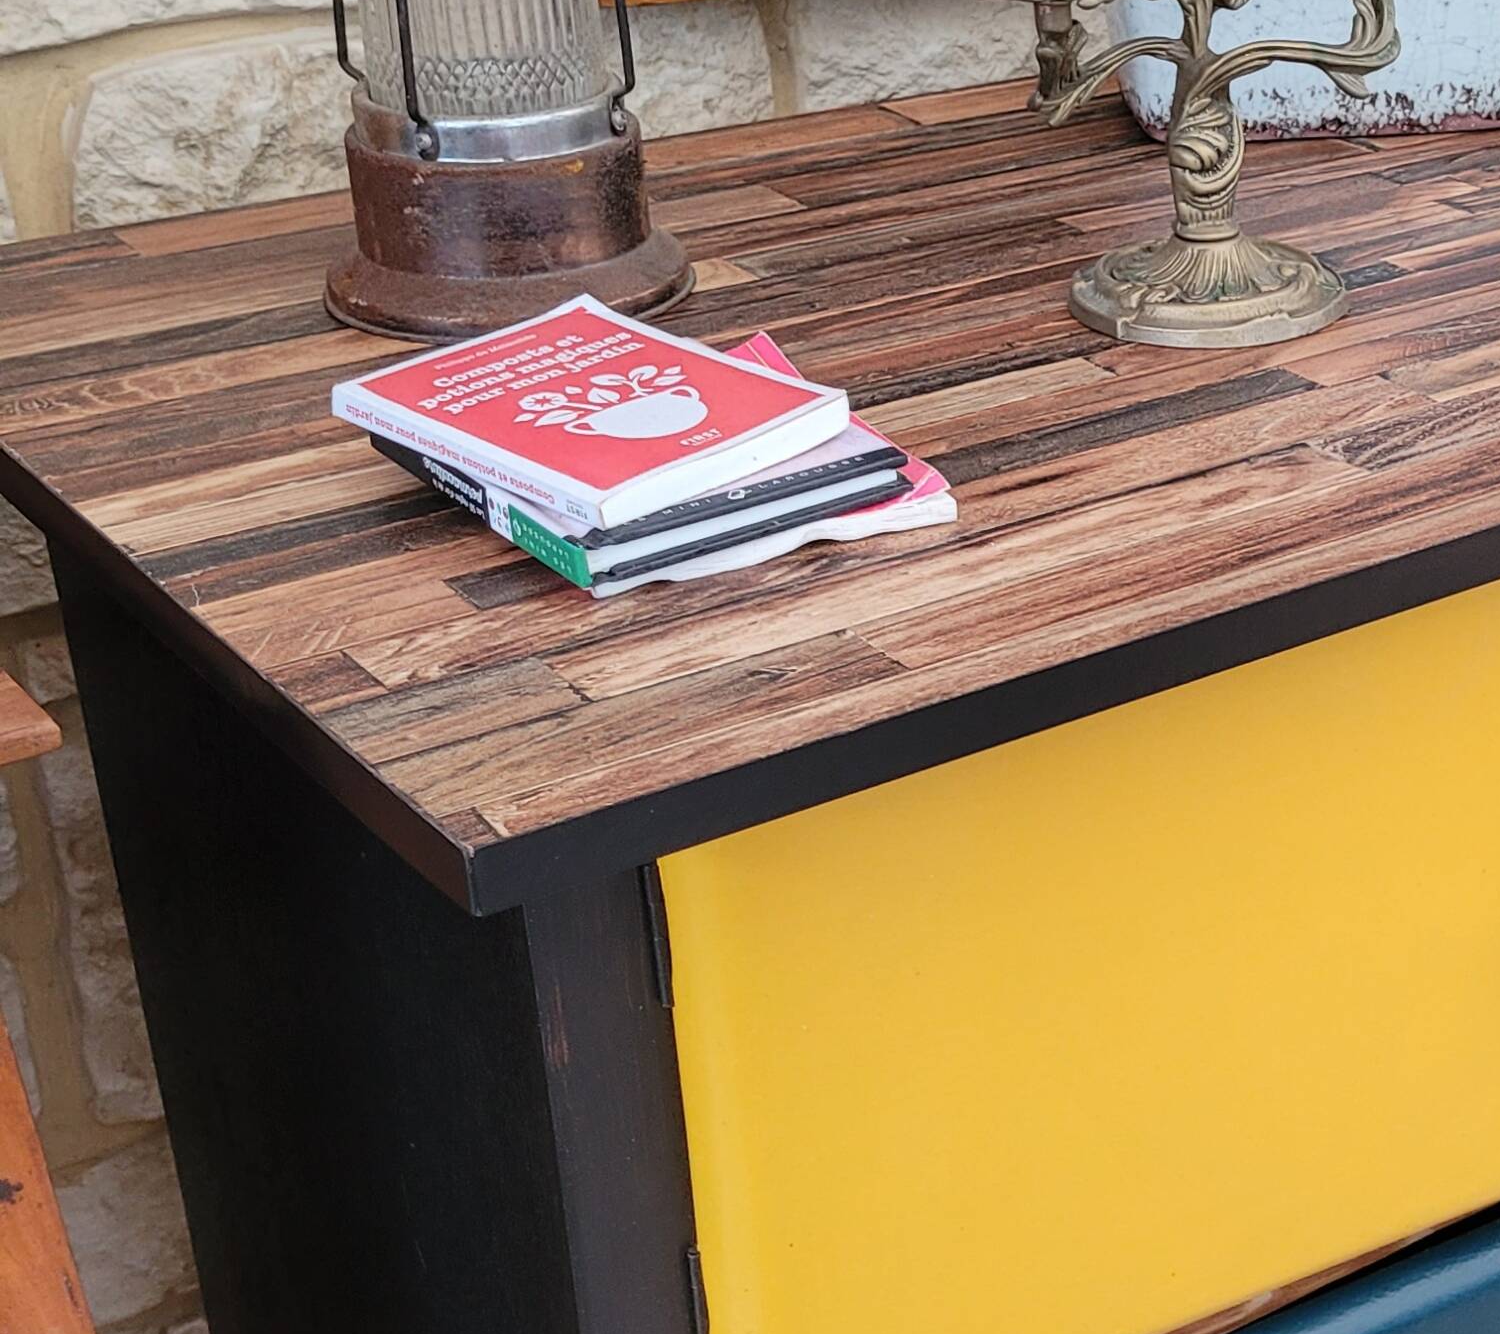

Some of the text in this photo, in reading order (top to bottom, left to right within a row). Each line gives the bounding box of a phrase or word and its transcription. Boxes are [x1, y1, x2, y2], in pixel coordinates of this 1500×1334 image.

[417, 371, 516, 410] potions
[514, 332, 632, 374] magiques
[433, 345, 554, 387] Composts
[556, 334, 585, 348] et
[443, 387, 506, 414] pour
[506, 369, 567, 390] mon
[563, 341, 646, 373] jardin
[345, 404, 374, 426] jardin
[374, 416, 395, 432] mon
[395, 426, 417, 443] pour
[418, 436, 460, 463] magiques
[461, 456, 497, 478] potions
[498, 471, 508, 483] et
[509, 477, 555, 505] Composts
